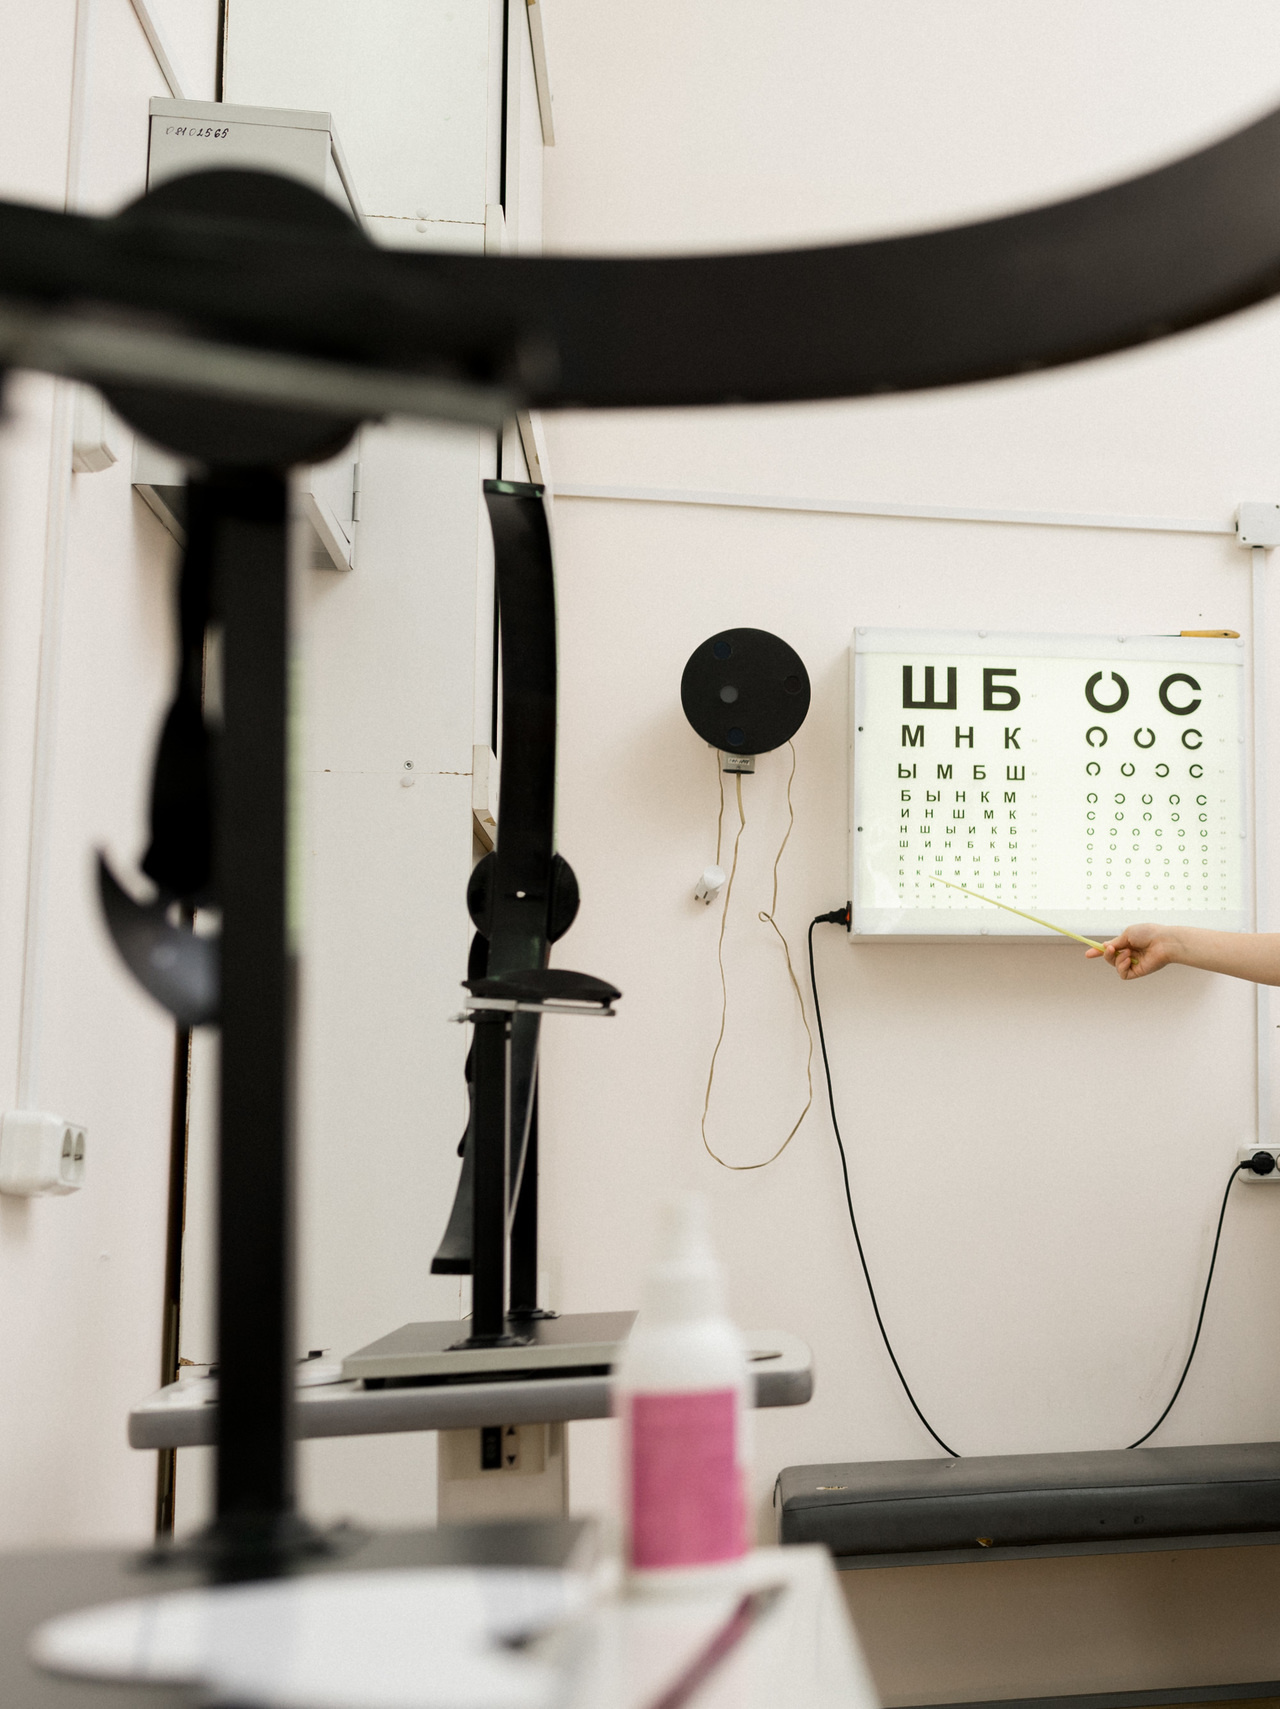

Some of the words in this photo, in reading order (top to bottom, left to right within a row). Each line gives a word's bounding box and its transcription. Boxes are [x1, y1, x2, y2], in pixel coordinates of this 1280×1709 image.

[902, 665, 957, 710] Ш
[983, 667, 1021, 712] Б
[902, 724, 924, 747] М
[955, 726, 974, 749] Н
[1004, 727, 1021, 750] К
[898, 763, 916, 779] Ы
[937, 764, 952, 780] М
[973, 765, 986, 780] Б
[1006, 765, 1025, 781] Ш
[901, 790, 911, 802] Б
[926, 790, 940, 802] Ы
[956, 791, 965, 802] Н
[981, 791, 990, 803] К
[1004, 792, 1016, 803] М
[901, 808, 909, 818] И
[925, 809, 933, 818] Н
[953, 809, 965, 819] Ш
[984, 810, 994, 819] М
[1009, 810, 1016, 819] К
[900, 824, 908, 834] Н
[920, 824, 930, 834] Ш
[946, 826, 956, 834] Ы
[968, 826, 976, 834] И
[990, 826, 998, 834] К
[1010, 826, 1018, 836] Б
[898, 840, 908, 848] Ш
[924, 840, 932, 848] И
[944, 840, 952, 848] Н
[968, 840, 974, 848] Б
[990, 840, 996, 848] К
[1008, 842, 1018, 850] Ы
